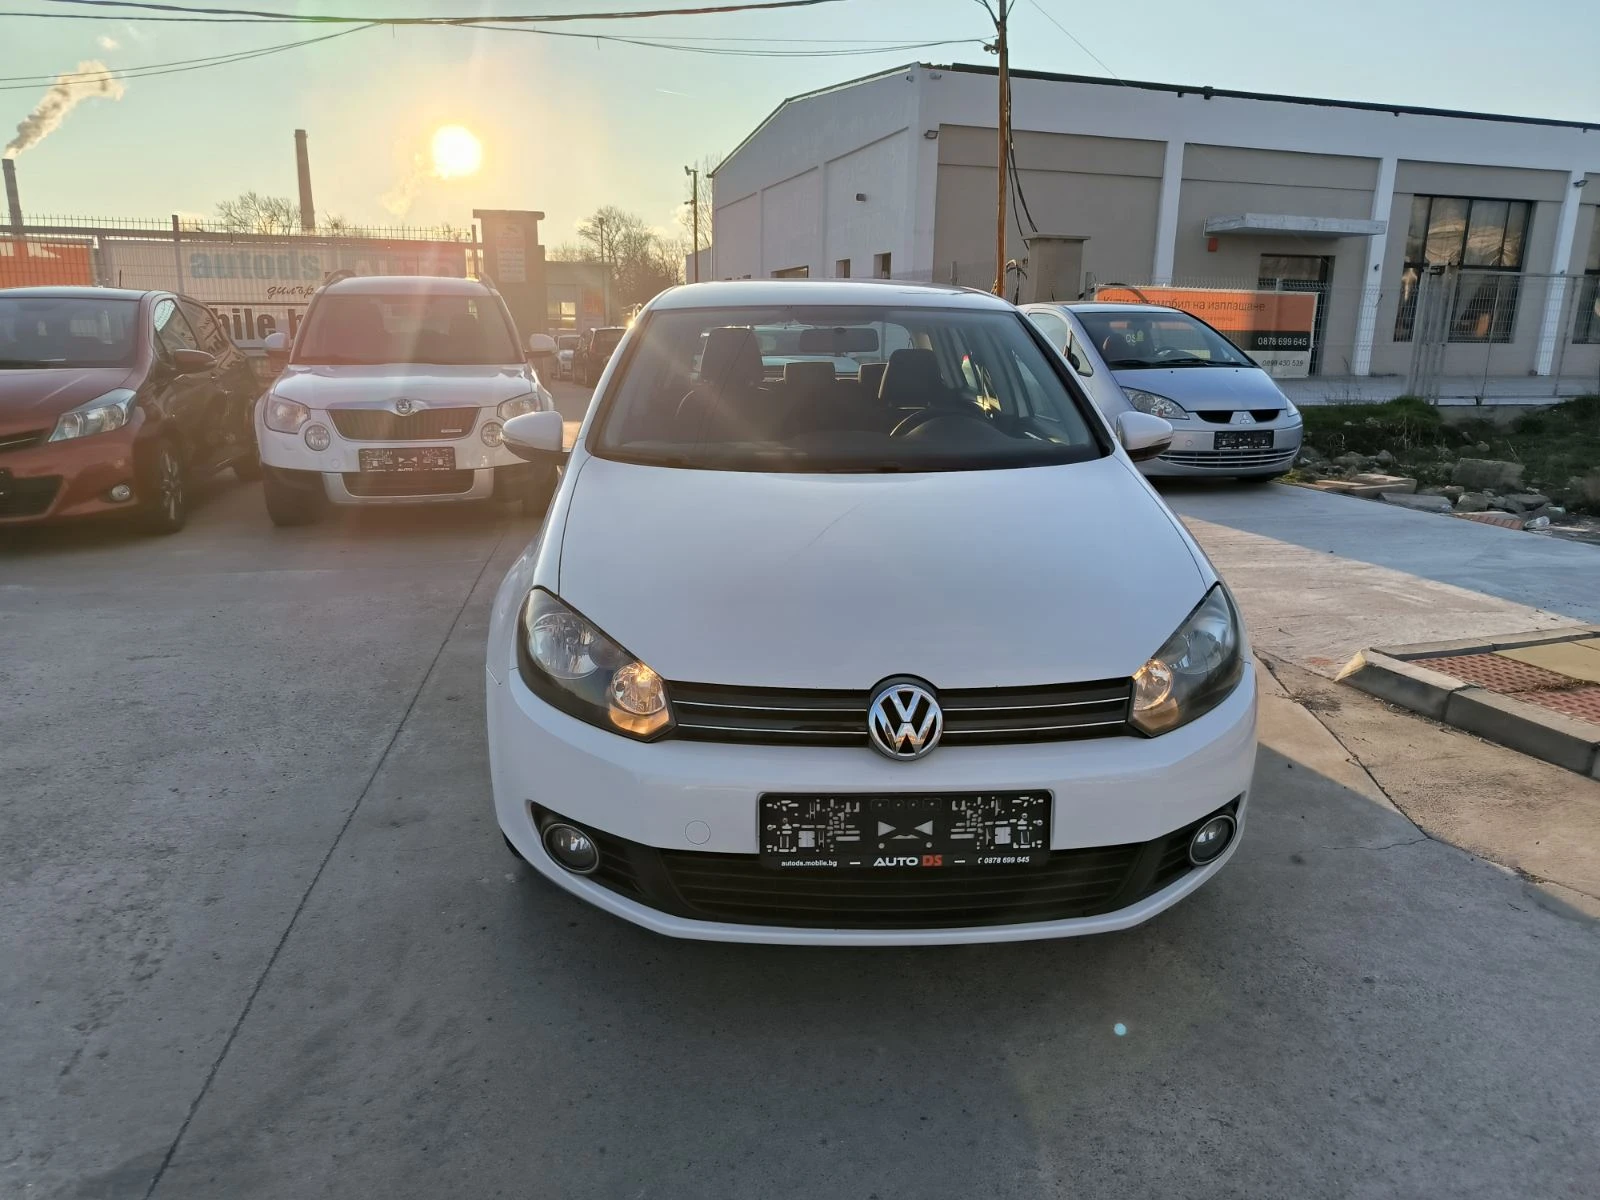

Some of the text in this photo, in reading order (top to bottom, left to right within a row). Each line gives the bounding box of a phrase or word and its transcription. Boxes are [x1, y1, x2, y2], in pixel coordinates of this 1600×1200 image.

[1257, 336, 1308, 346] 0878 699 645
[873, 857, 919, 867] AUTO
[922, 855, 942, 867] DS
[983, 856, 1002, 865] 0878
[1002, 856, 1016, 865] 699
[1016, 855, 1031, 864] 645
